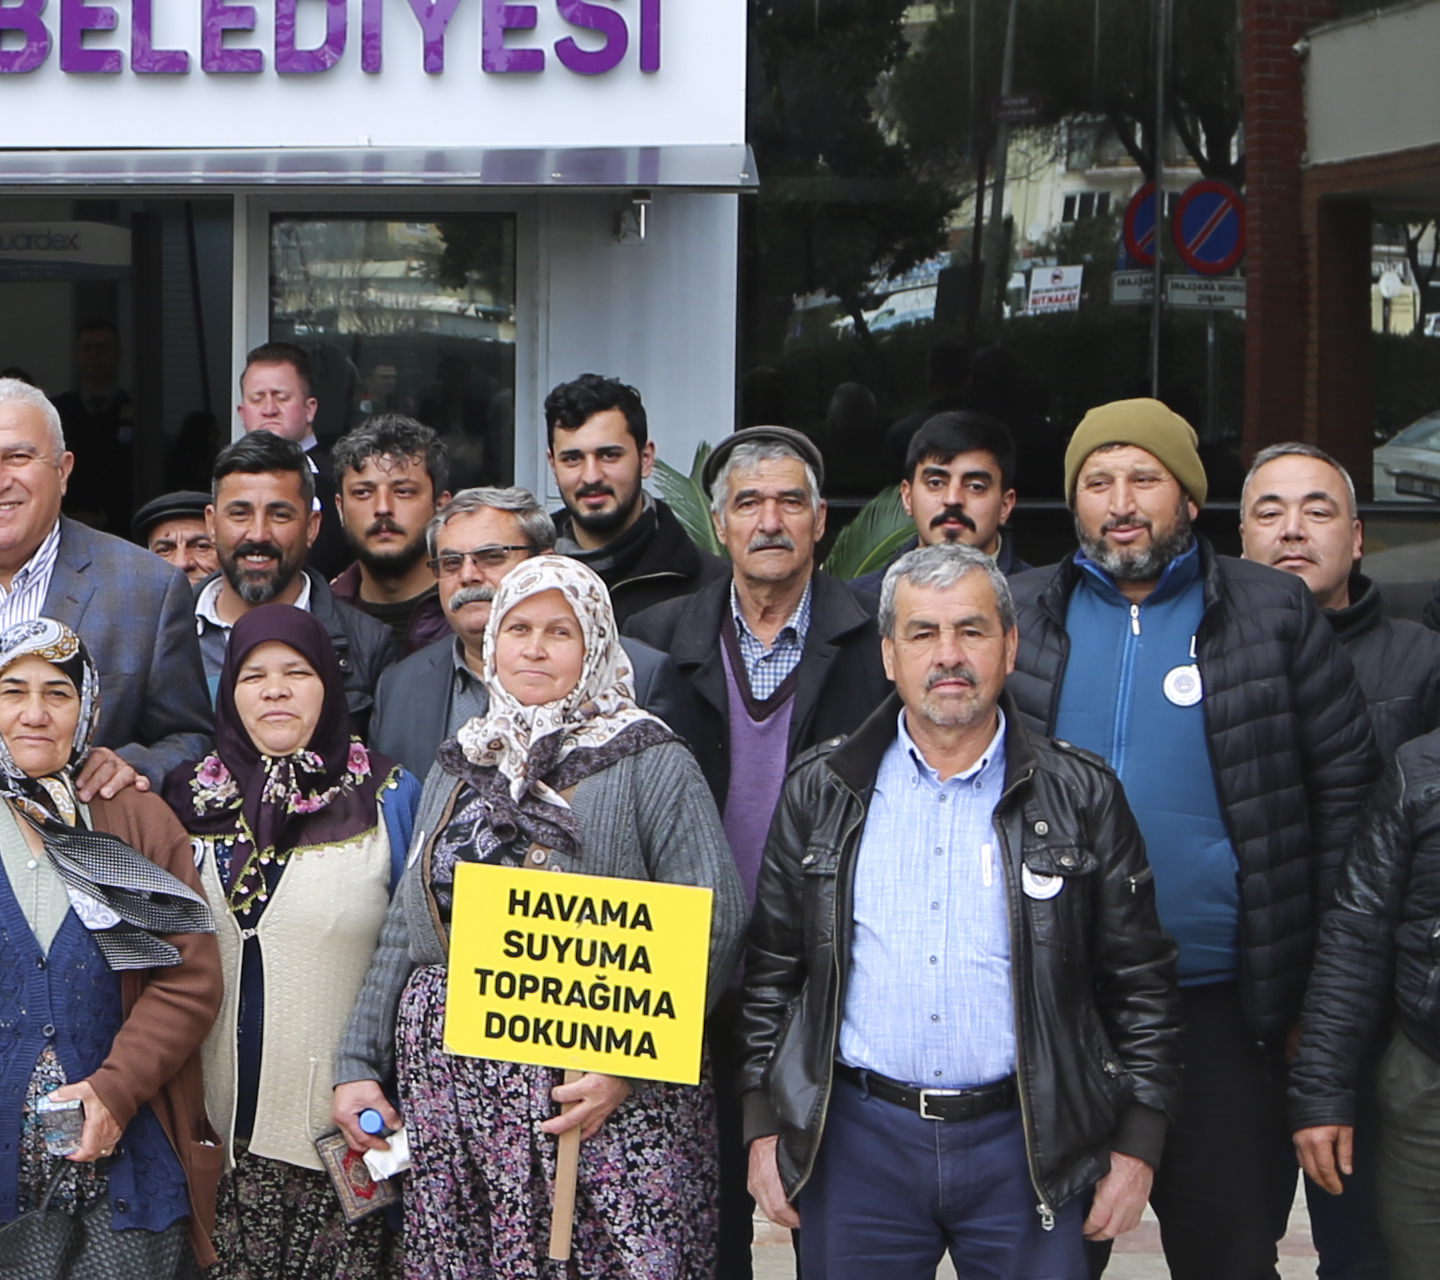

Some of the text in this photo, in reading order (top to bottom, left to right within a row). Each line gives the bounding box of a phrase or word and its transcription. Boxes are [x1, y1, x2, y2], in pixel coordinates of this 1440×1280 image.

[507, 888, 654, 932] HAVAMA
[503, 929, 652, 974] SUYUMA
[474, 967, 676, 1020] TOPRAĞIMA
[484, 1012, 658, 1060] DOKUNMA
